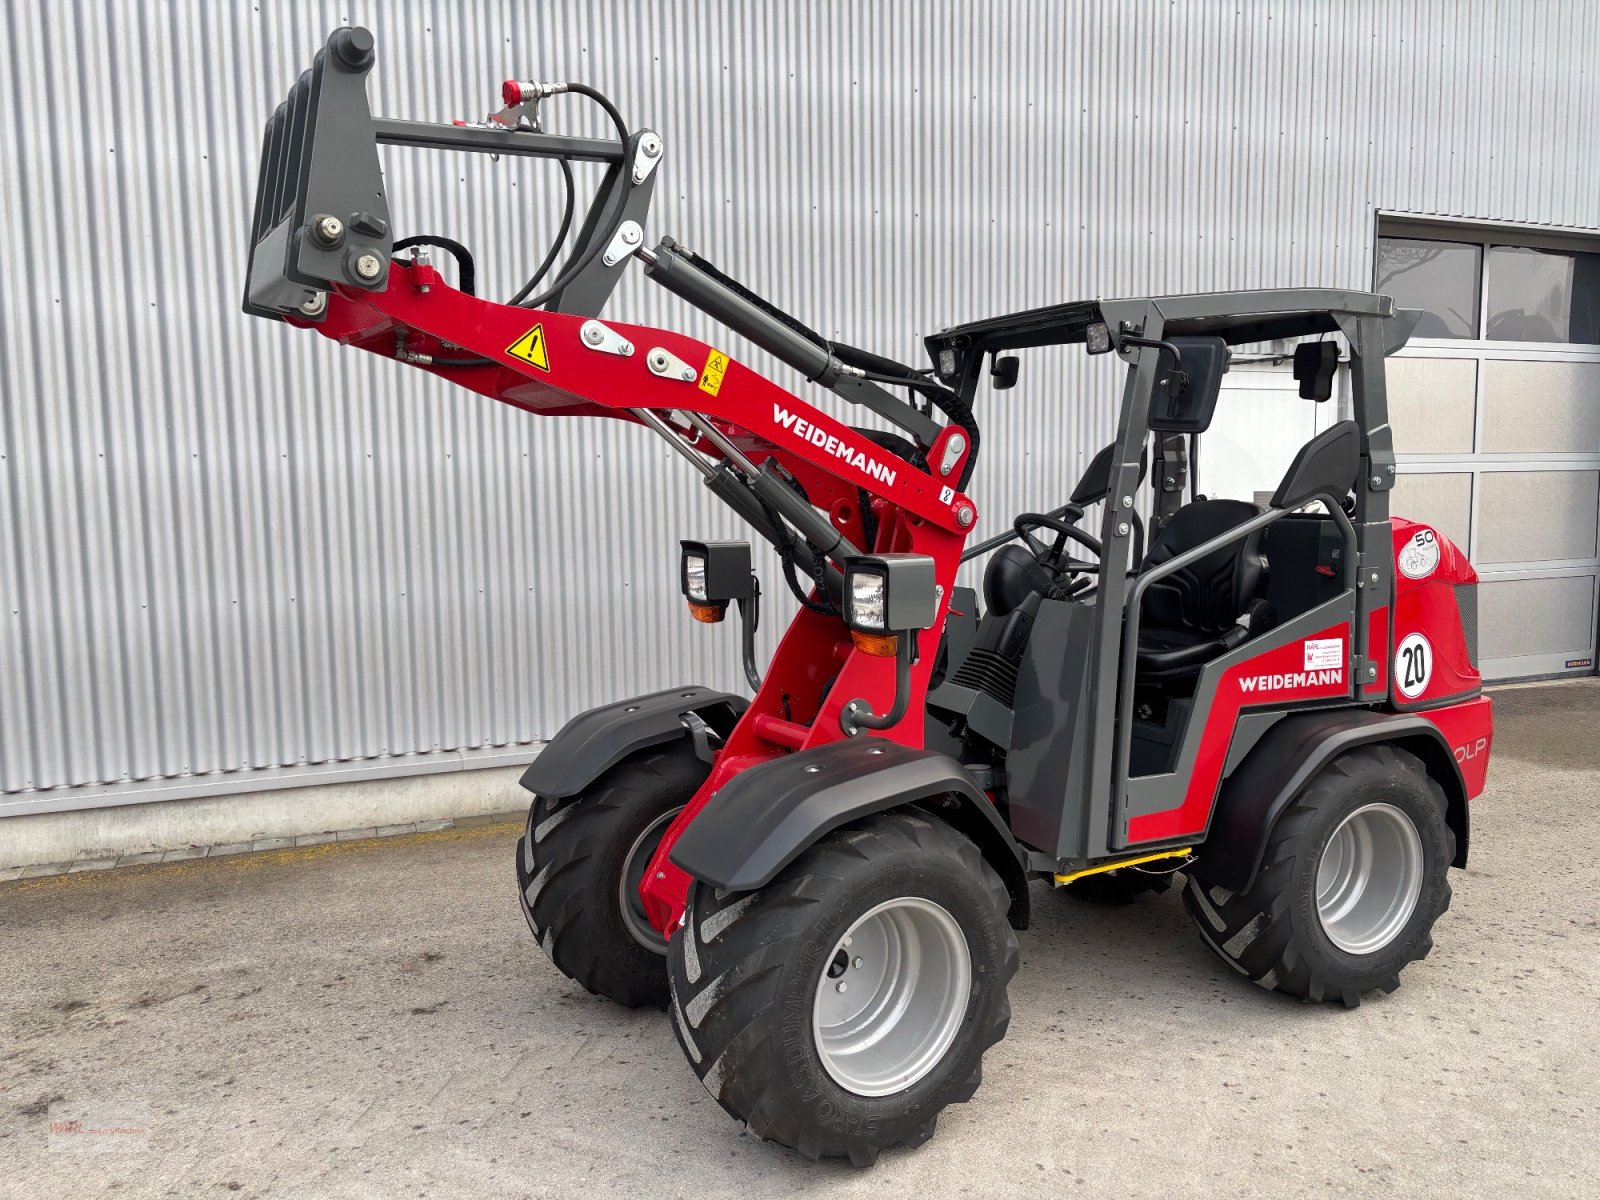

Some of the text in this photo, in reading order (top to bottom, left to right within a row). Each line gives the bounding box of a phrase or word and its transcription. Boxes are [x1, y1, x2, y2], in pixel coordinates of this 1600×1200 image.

[773, 403, 897, 487] WEIDEMANN
[1415, 530, 1434, 547] 50
[1238, 669, 1342, 693] WEIDEMANN
[1402, 643, 1425, 689] 20
